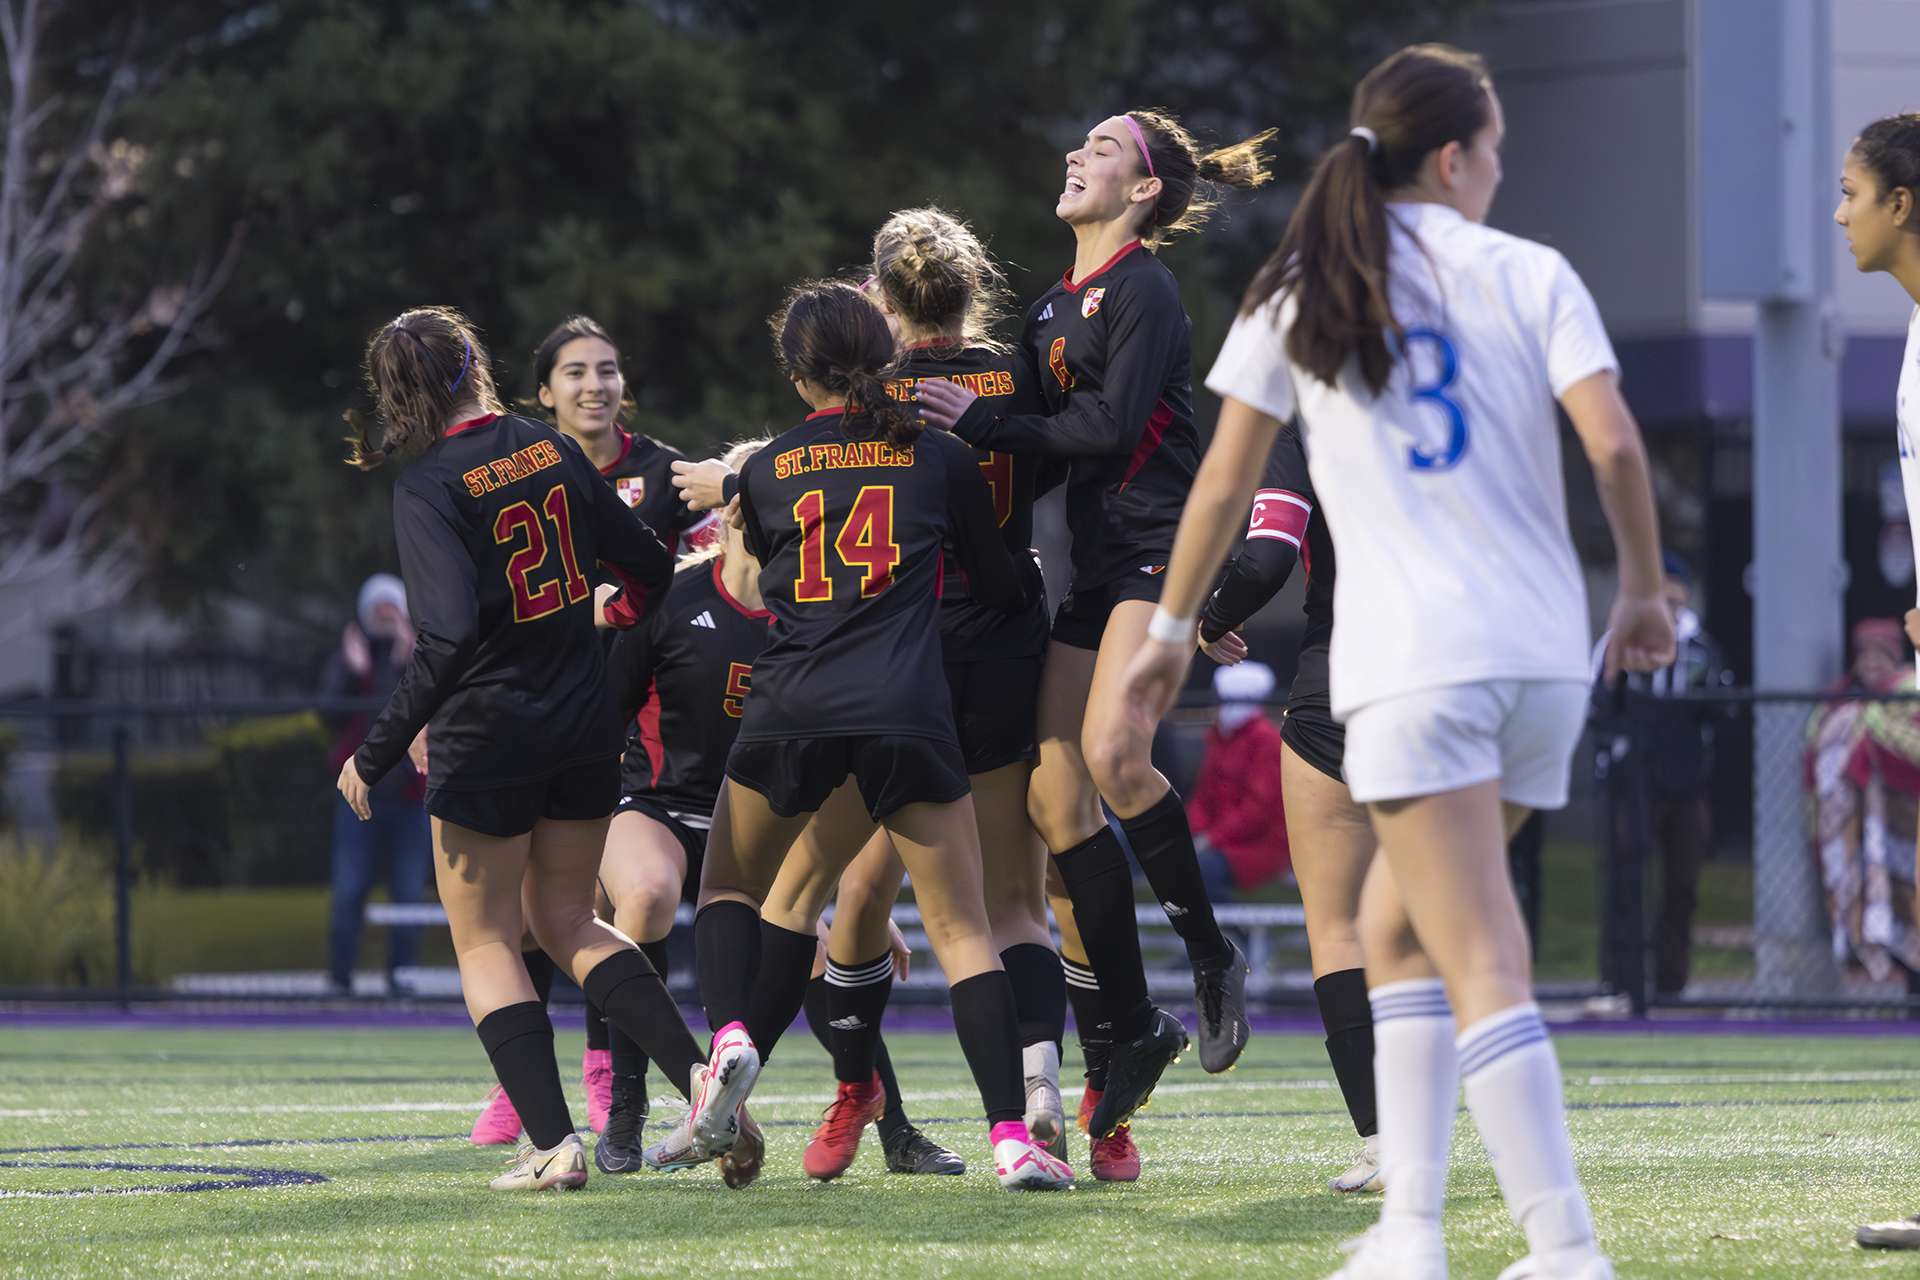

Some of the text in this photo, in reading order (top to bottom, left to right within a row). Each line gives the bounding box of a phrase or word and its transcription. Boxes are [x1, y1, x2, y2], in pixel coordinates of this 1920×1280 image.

[1404, 328, 1469, 472] 3
[493, 484, 590, 623] 21
[793, 485, 900, 602] 14
[1250, 502, 1267, 528] C
